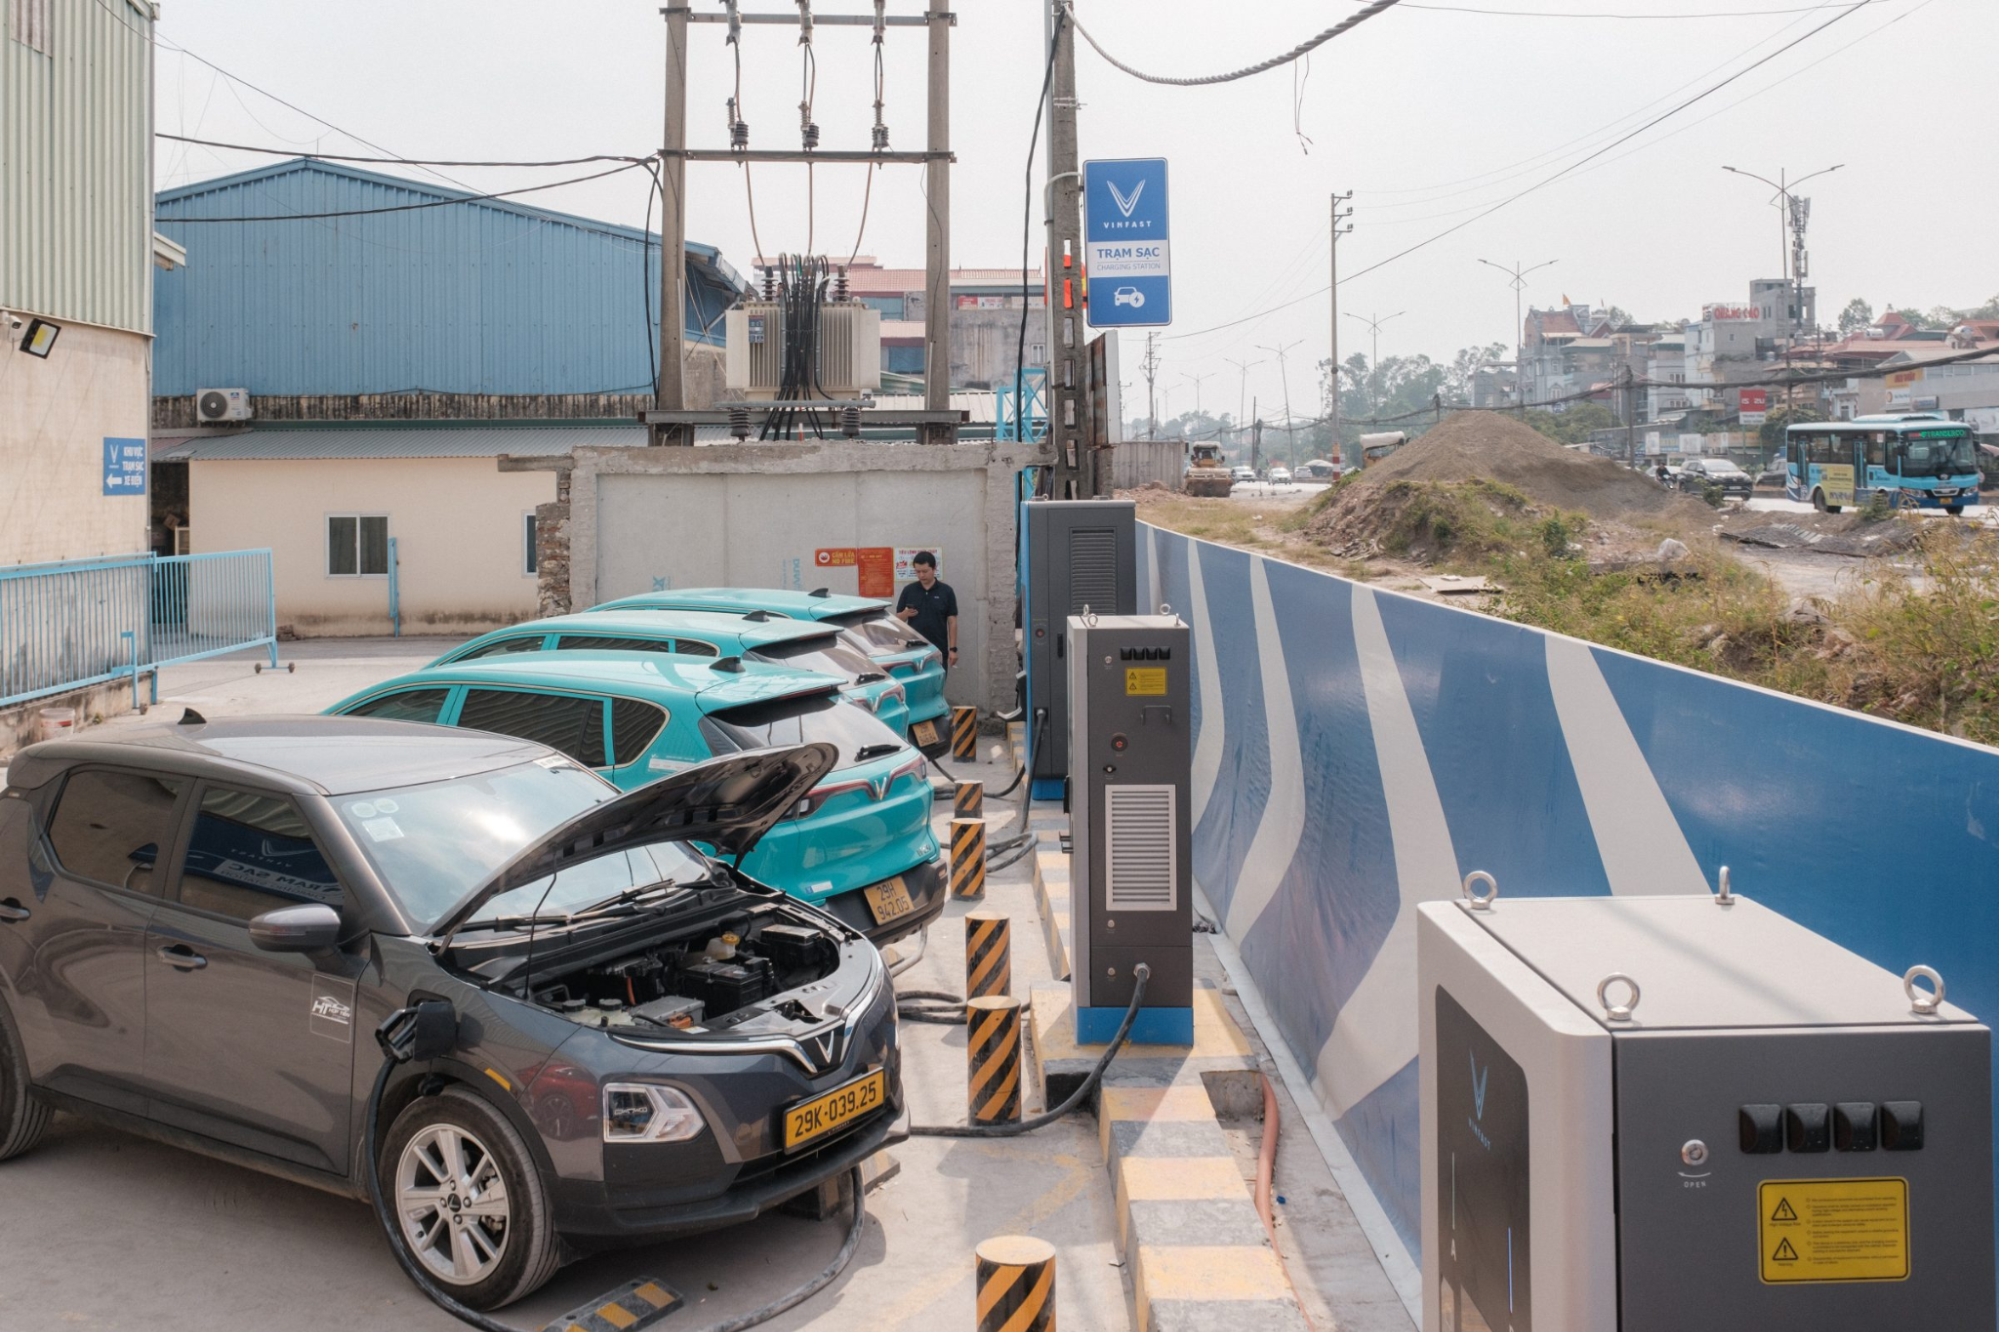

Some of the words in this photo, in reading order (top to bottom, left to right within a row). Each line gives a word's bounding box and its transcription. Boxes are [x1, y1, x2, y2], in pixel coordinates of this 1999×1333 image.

[1103, 221, 1151, 229] VINFAST
[1097, 248, 1132, 261] TRẠM
[1135, 247, 1160, 260] SẠC
[876, 882, 897, 901] 29H
